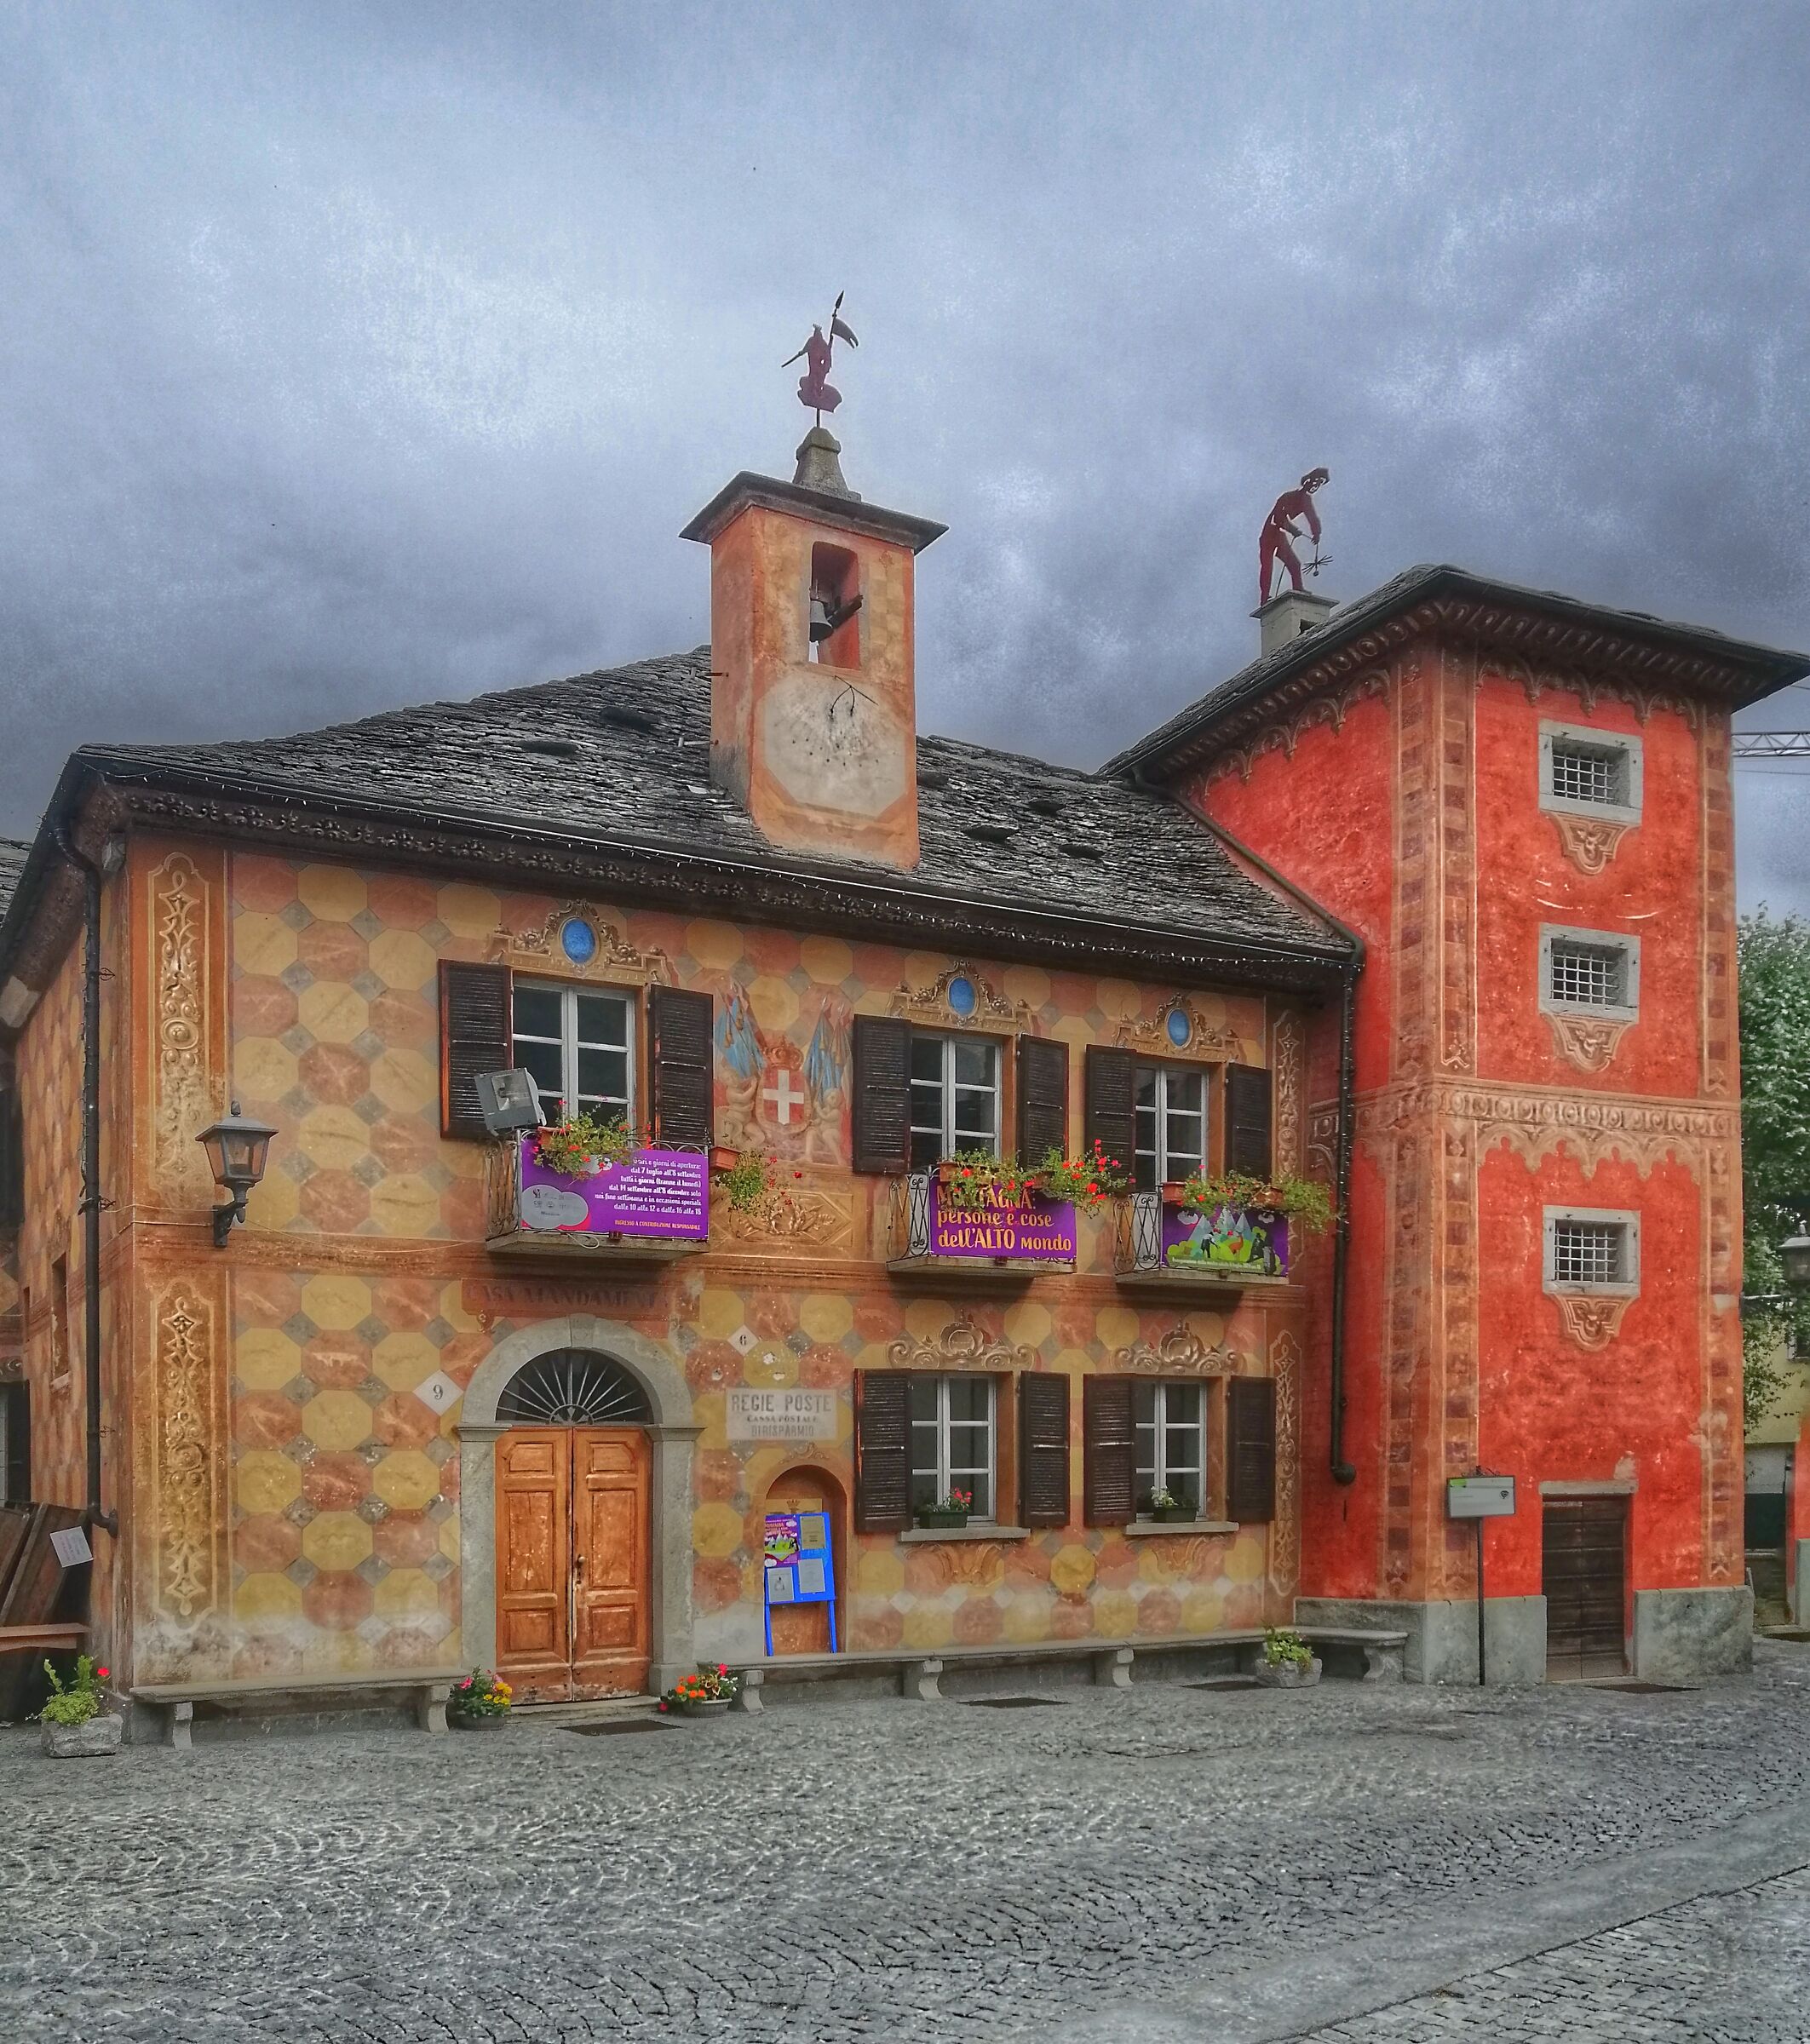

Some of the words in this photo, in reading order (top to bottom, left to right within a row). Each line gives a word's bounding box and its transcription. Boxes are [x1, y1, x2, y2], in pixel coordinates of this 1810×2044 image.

[652, 1158, 669, 1168] giorni
[646, 1168, 663, 1176] luglio
[638, 1176, 655, 1185] giorni
[667, 1187, 690, 1196] dicembre
[617, 1193, 644, 1202] settimana
[938, 1210, 1003, 1228] persone
[1007, 1213, 1014, 1226] e
[1020, 1214, 1054, 1227] cose
[938, 1227, 1015, 1250] dell'ALTO
[433, 1384, 444, 1400] 9
[732, 1394, 774, 1412] REGIE
[784, 1395, 832, 1414] POSTE
